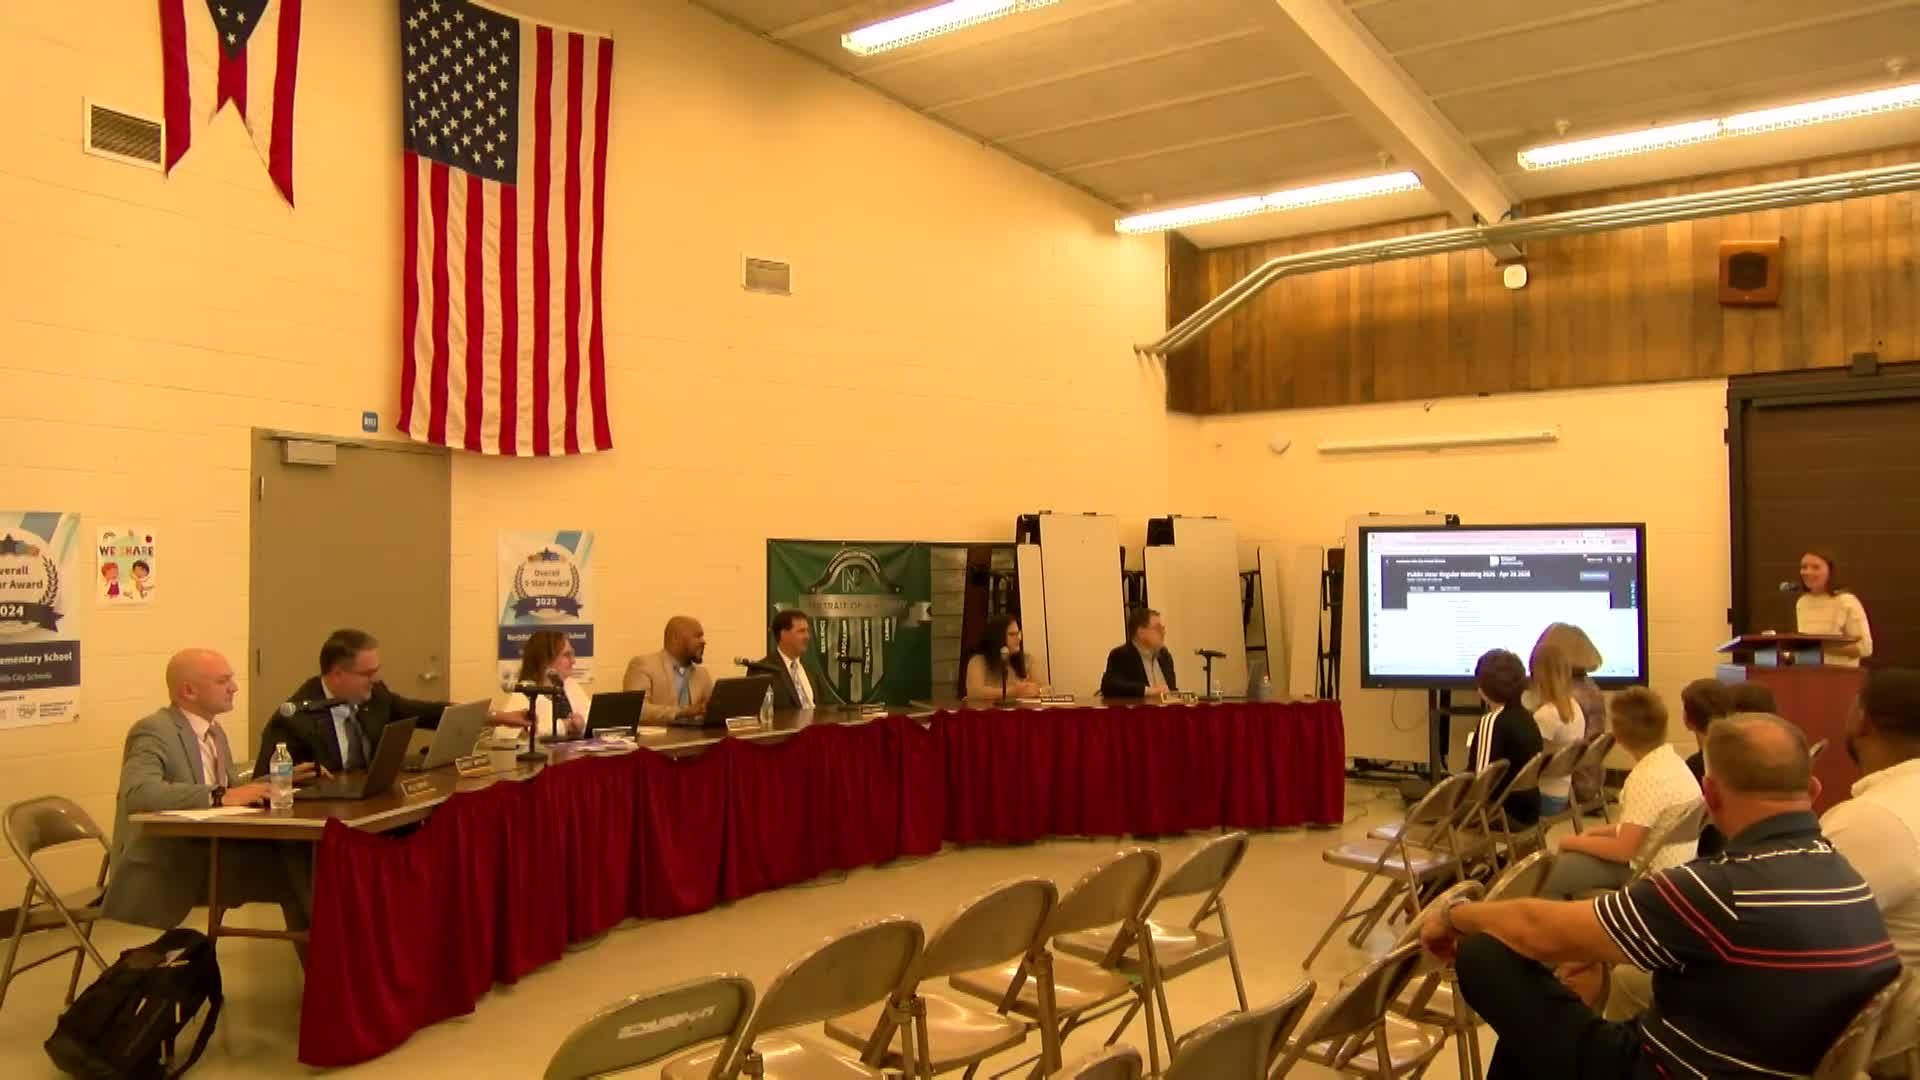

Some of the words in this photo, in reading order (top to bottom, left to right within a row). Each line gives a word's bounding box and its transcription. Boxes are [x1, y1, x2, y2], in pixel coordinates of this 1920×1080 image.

[99, 545, 115, 556] WE
[9, 580, 43, 589] Award
[0, 604, 24, 617] 024
[43, 651, 72, 662] School
